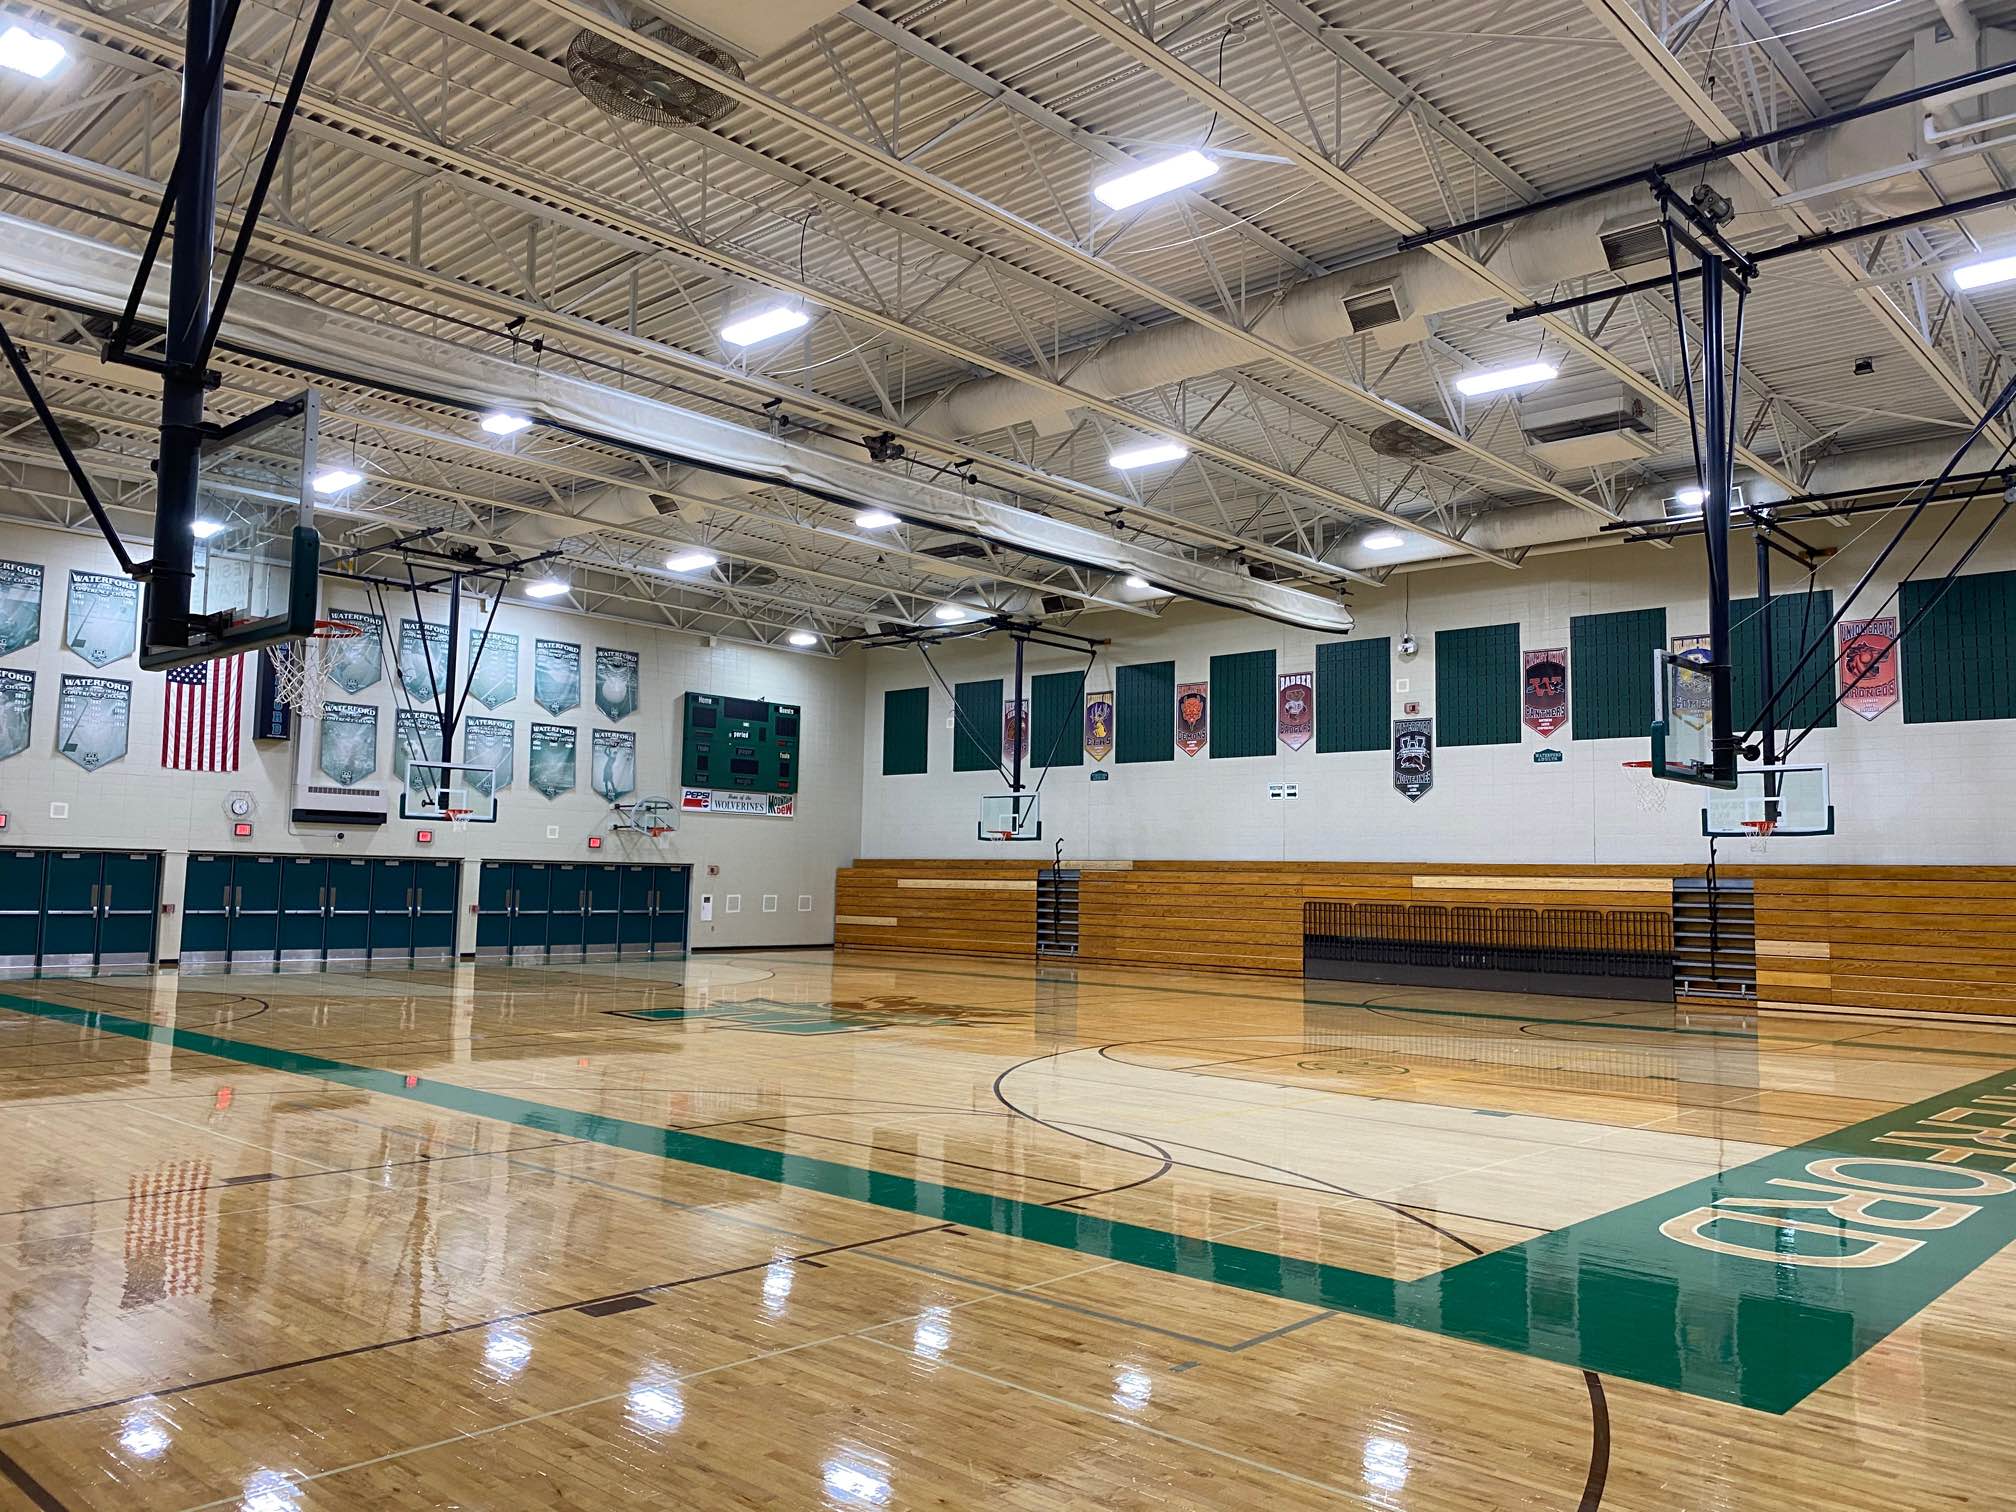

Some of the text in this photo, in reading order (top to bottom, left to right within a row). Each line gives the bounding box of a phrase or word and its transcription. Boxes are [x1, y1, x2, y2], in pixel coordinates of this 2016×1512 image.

[72, 572, 137, 590] WATERFORD
[331, 612, 382, 626] WATERFORD
[403, 622, 450, 636] WATRFORD
[1840, 620, 1895, 642] UNION GROVE
[537, 642, 579, 654] WATERFORD
[597, 650, 638, 662] WATERFORD
[64, 678, 130, 692] WATERFORD
[1280, 674, 1312, 691] BADGER
[63, 689, 103, 698] CONFERENCE
[324, 705, 376, 717] WATERFORD
[1525, 703, 1565, 719] PANTHERS
[467, 719, 513, 730] WATERFORD
[533, 725, 576, 736] WATERFORD
[594, 731, 635, 742] WATERFORD
[733, 731, 749, 739] period
[1178, 728, 1206, 741] DEMONS
[685, 790, 711, 799] PEPSI
[714, 800, 765, 812] WOLVERINES
